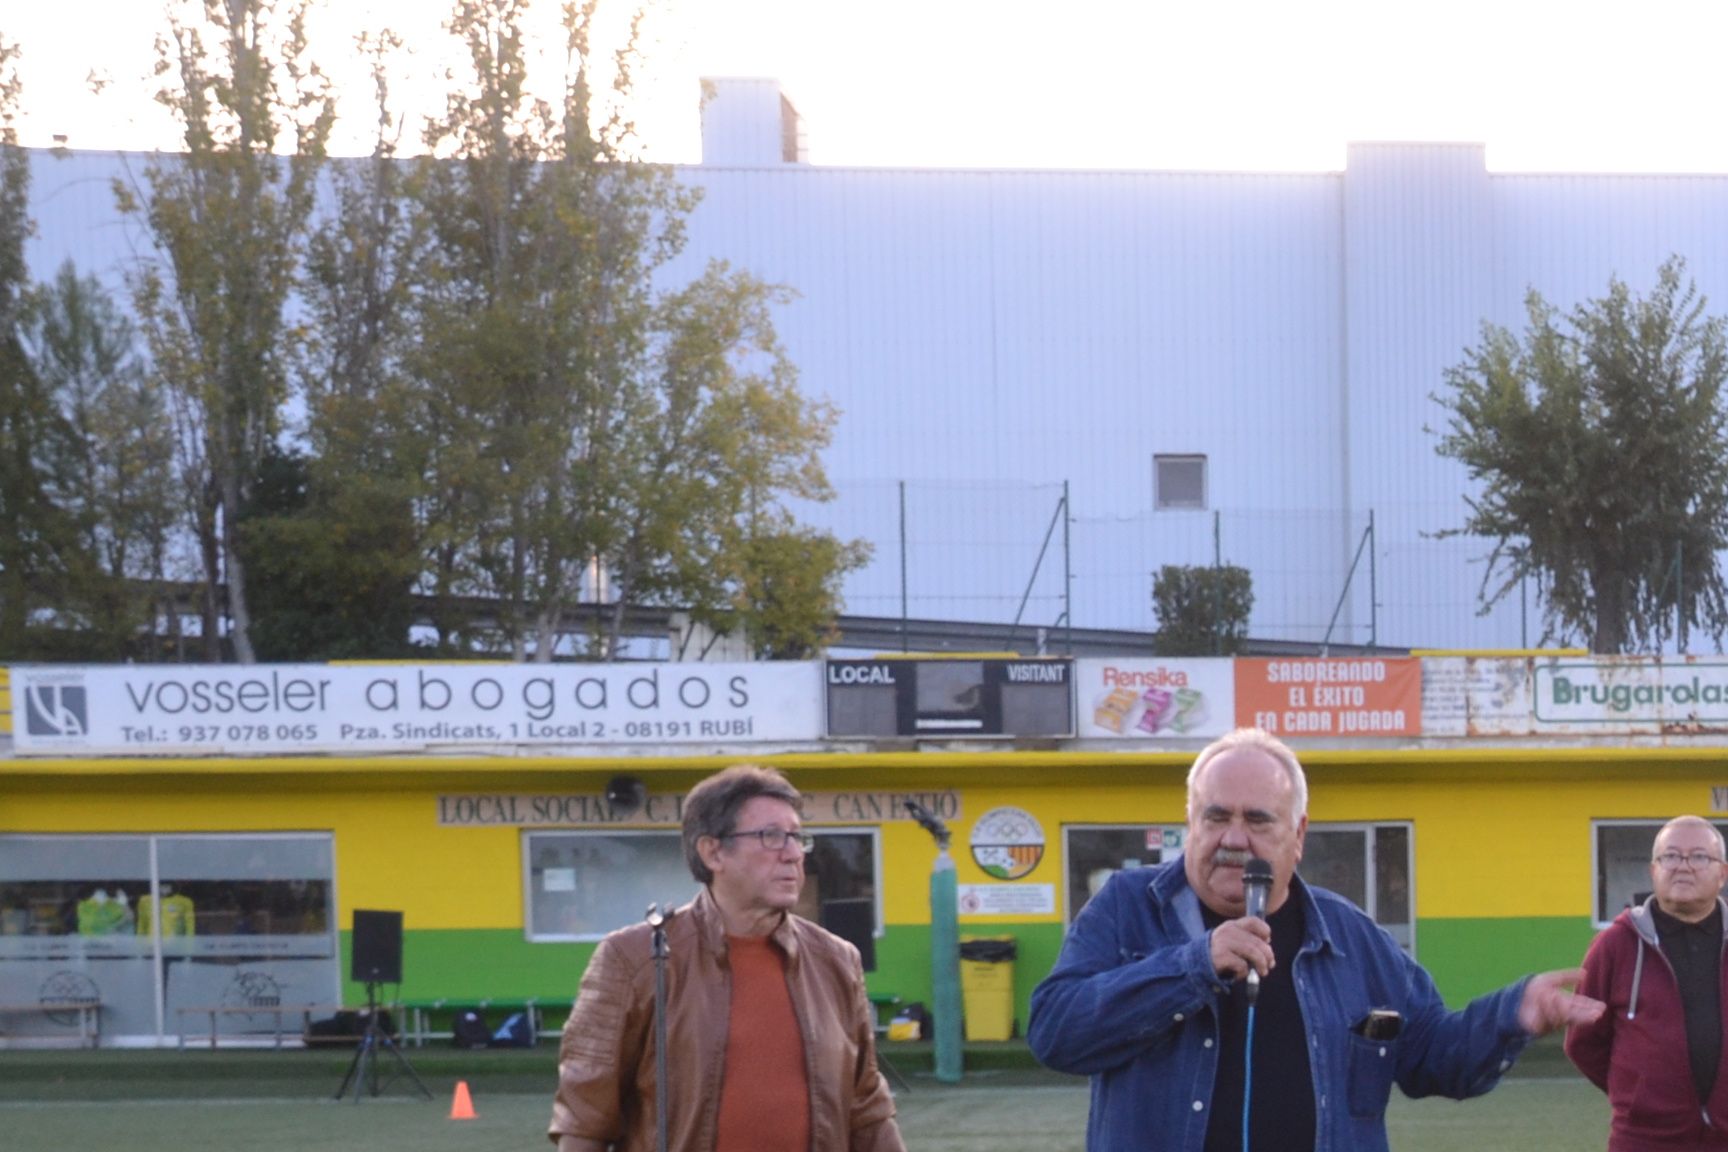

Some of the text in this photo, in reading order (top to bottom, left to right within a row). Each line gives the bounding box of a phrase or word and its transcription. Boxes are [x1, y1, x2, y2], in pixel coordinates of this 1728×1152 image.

[828, 665, 895, 684] LOCAL
[1007, 664, 1065, 682] VISITANT
[1103, 667, 1188, 687] Rensika
[1267, 662, 1386, 682] SABOREANDO
[126, 668, 750, 720] vosseler abogados
[1289, 682, 1365, 706] EL ÉXITO
[121, 726, 167, 742] Tel.:
[178, 726, 220, 742] 937
[227, 725, 269, 741] 078
[276, 725, 318, 740] 065
[340, 724, 386, 740] Pza.
[392, 721, 501, 740] Sindicats,
[510, 723, 519, 738] 1
[528, 721, 586, 738] Local
[592, 722, 606, 738] 2
[625, 721, 692, 737] 08191
[701, 717, 753, 736] RUBÍ
[1284, 711, 1332, 731] CADA
[1338, 710, 1405, 733] JUGADA
[440, 795, 525, 823] LOCAL
[834, 792, 882, 820] CAN
